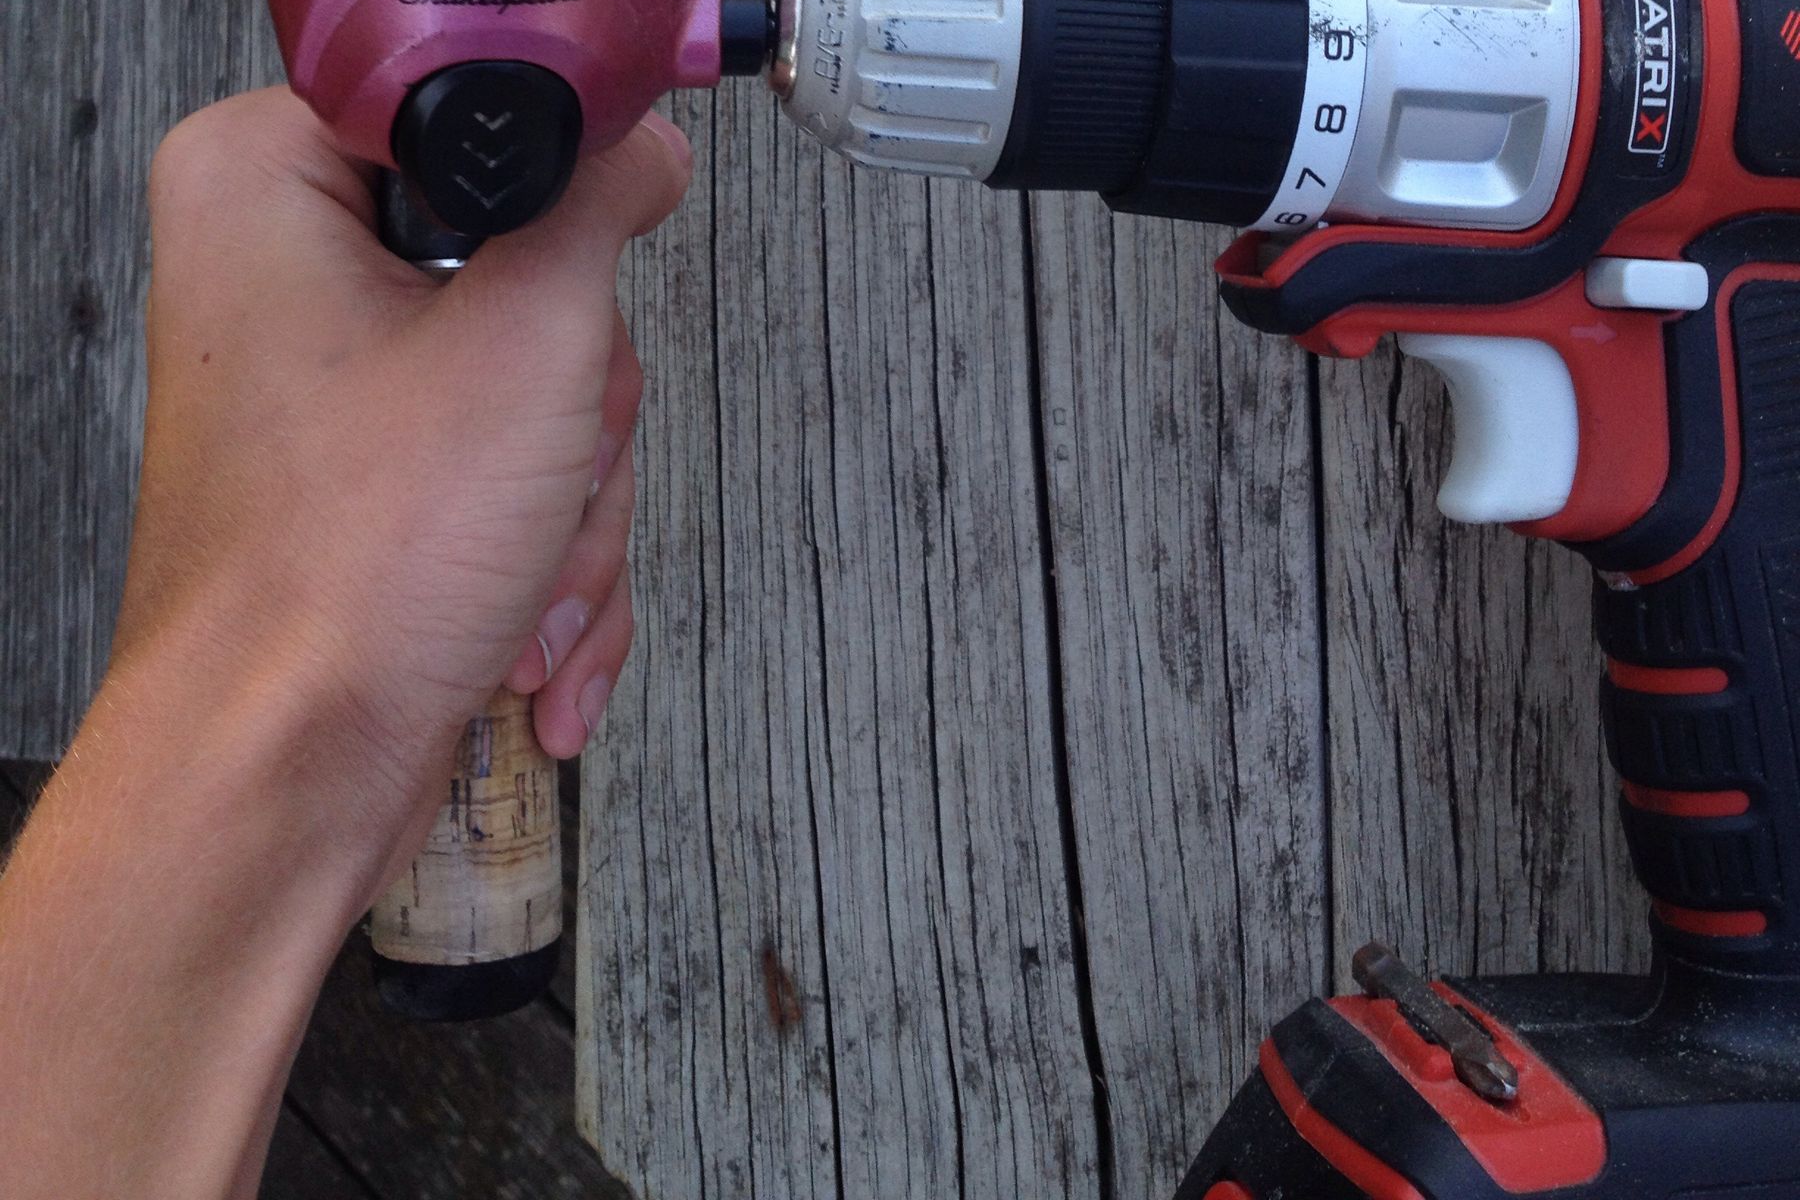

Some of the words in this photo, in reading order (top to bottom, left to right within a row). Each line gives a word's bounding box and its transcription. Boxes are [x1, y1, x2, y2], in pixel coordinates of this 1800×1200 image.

[1324, 28, 1355, 62] 9
[1314, 103, 1347, 134] 8
[1295, 167, 1326, 190] 7
[1275, 211, 1307, 225] 6
